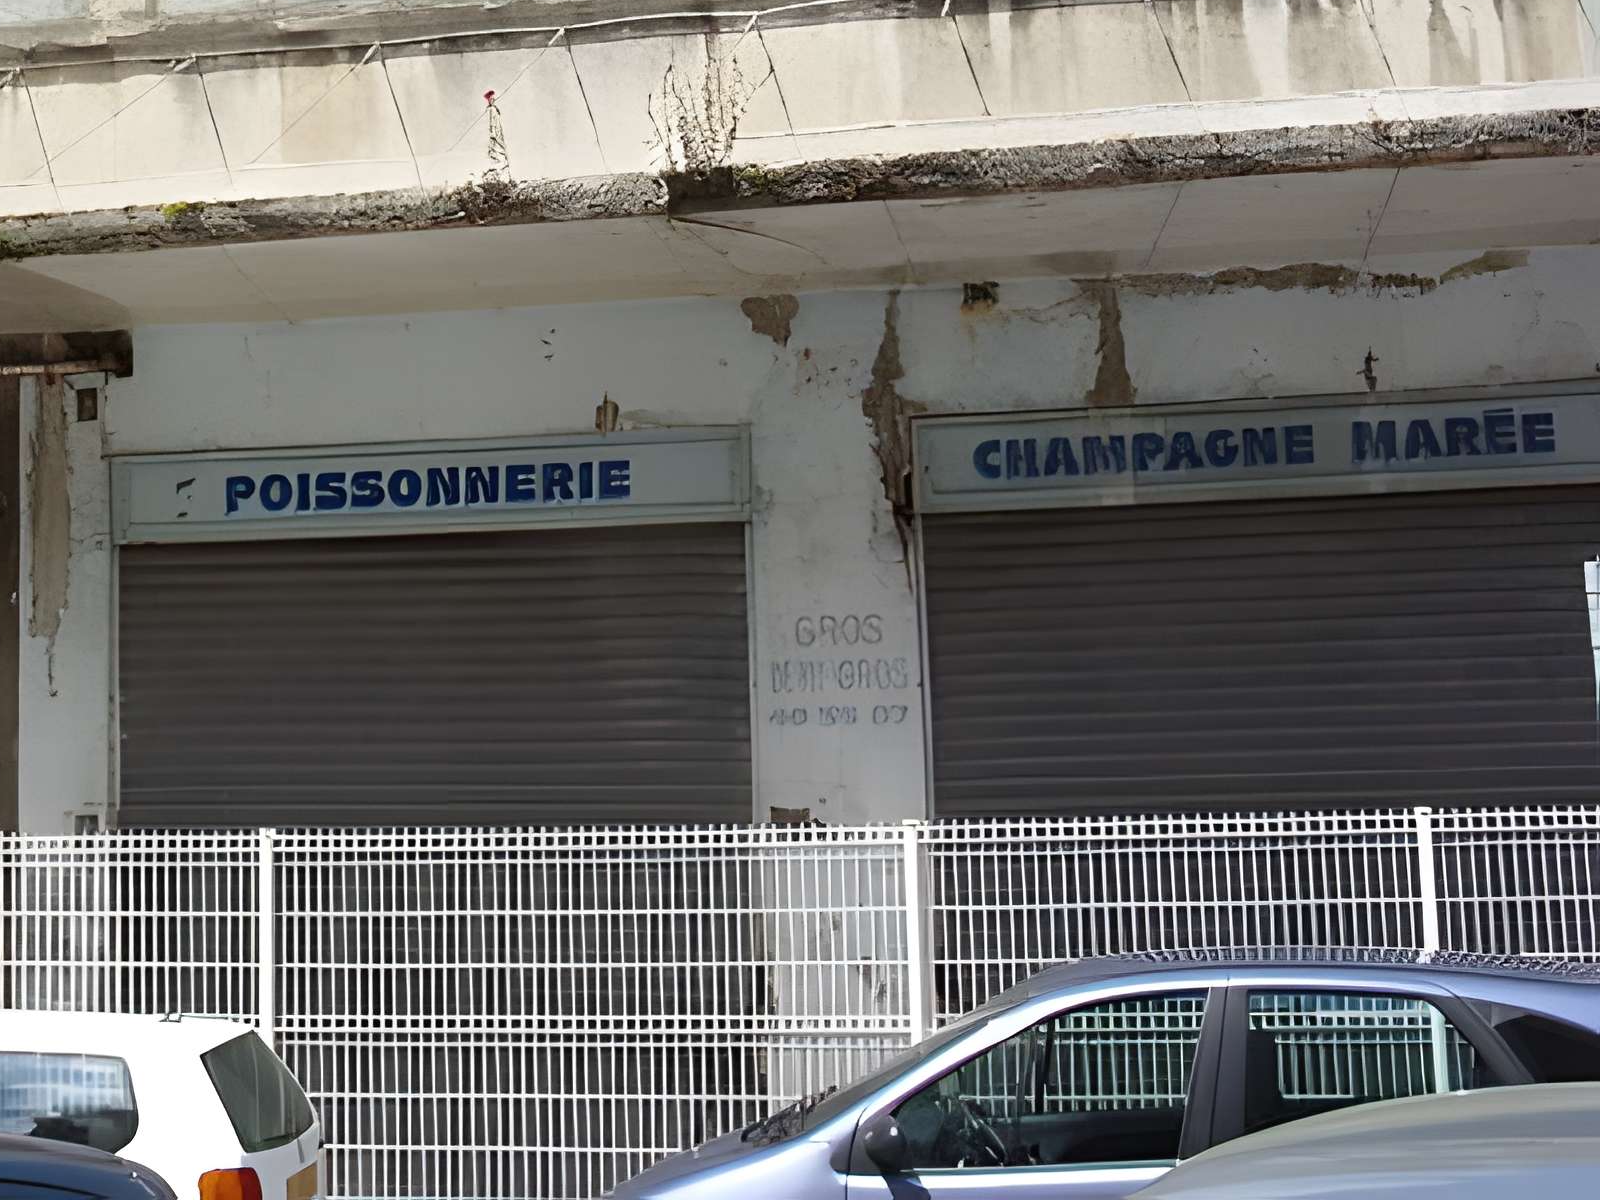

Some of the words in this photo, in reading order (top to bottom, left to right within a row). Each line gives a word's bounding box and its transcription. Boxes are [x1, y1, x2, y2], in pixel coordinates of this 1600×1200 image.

[972, 424, 1314, 479] CHAMPAGNE
[225, 460, 631, 515] POISSONNERIE
[795, 614, 883, 646] GROS
